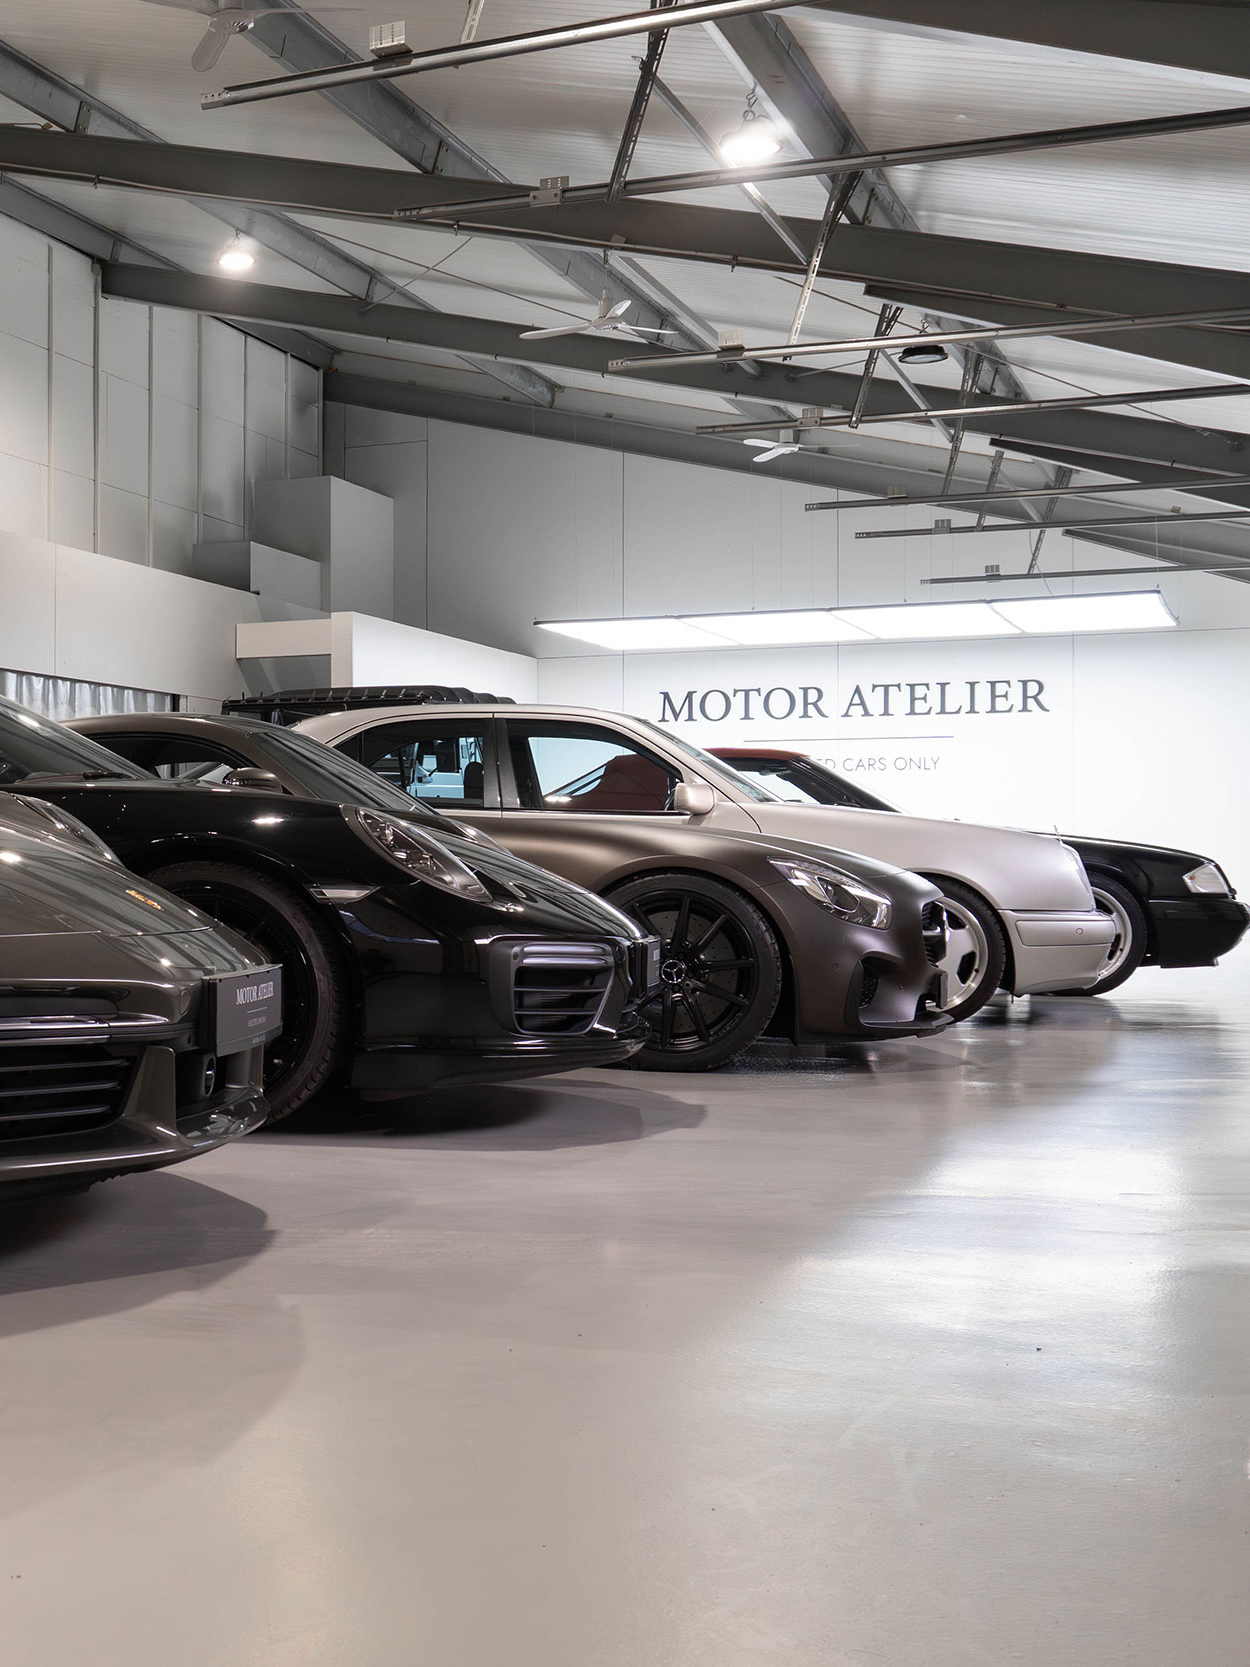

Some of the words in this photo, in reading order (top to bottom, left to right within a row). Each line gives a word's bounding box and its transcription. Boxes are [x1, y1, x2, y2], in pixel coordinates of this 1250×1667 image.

[657, 686, 829, 723] MOTOR
[840, 678, 1051, 718] ATELIER
[842, 757, 887, 772] CARS
[893, 756, 941, 771] ONLY
[236, 985, 257, 1005] MOTOR
